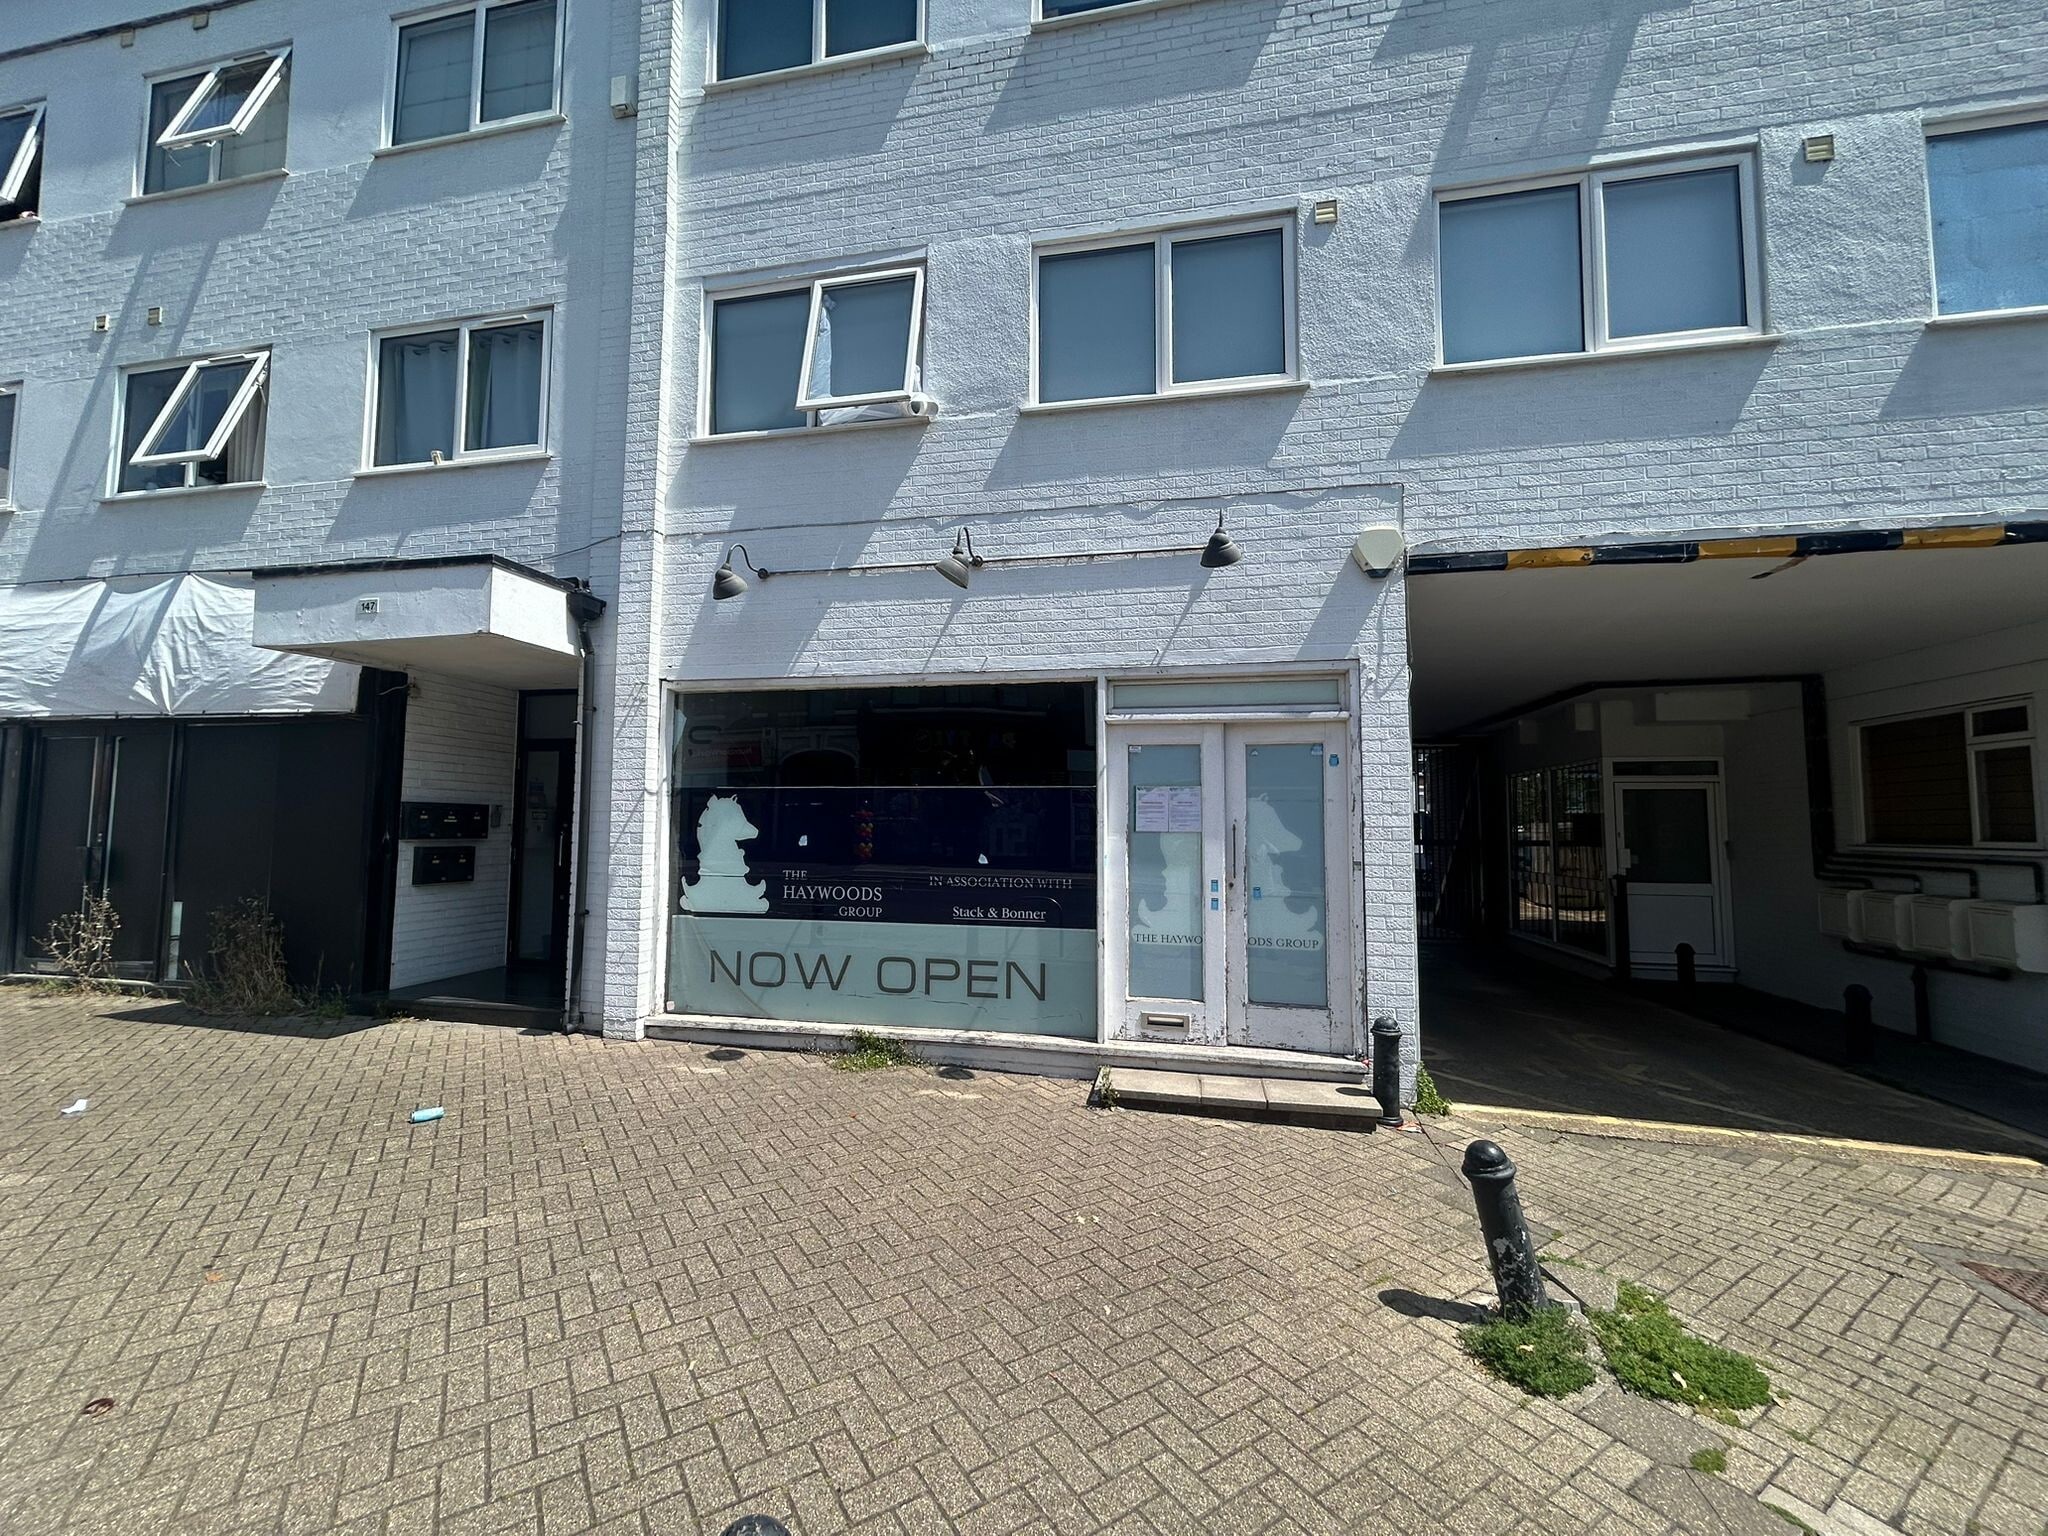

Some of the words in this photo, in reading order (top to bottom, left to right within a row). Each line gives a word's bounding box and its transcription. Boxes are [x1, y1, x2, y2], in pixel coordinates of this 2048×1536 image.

[361, 601, 375, 611] 147
[782, 869, 808, 880] THE
[929, 875, 943, 886] IN
[946, 876, 1034, 888] ASSOCIATION
[1036, 878, 1073, 889] WITH
[783, 885, 883, 901] HAYWOODS
[838, 906, 883, 917] GROUP
[952, 906, 984, 918] Stack
[987, 907, 998, 918] &
[1002, 907, 1047, 920] Bonner
[1133, 933, 1158, 943] THE
[1275, 937, 1320, 949] GROUP
[710, 950, 852, 991] NOW
[876, 956, 1046, 1001] OPEN
